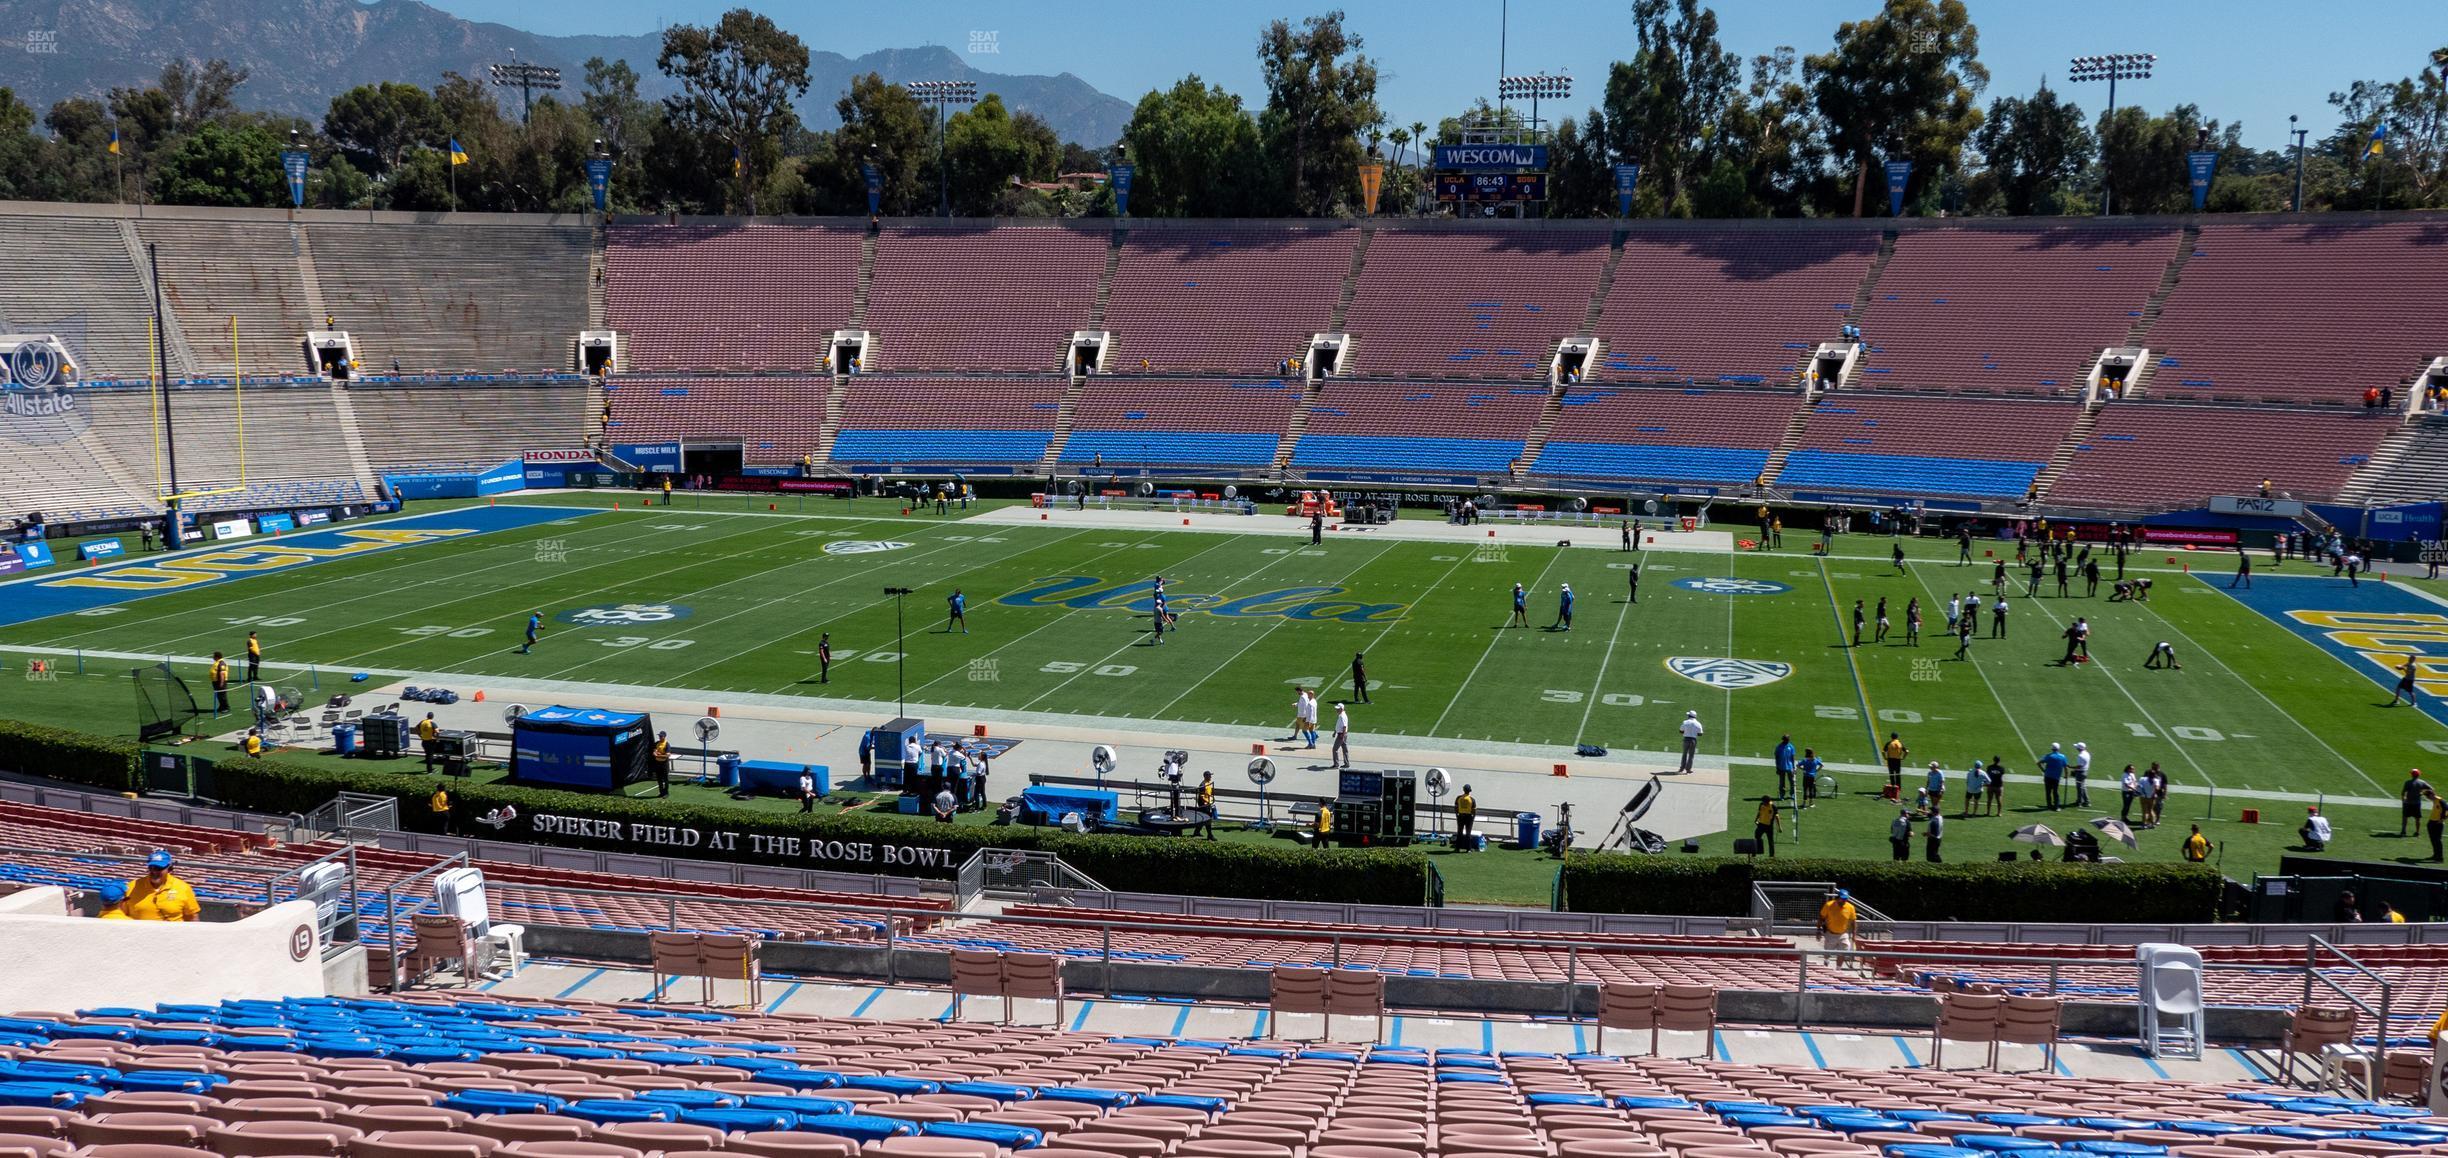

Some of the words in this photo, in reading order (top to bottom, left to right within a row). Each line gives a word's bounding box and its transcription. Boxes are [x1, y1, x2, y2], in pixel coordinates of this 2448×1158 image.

[1447, 149, 1514, 164] WESCOM
[1476, 176, 1503, 186] 86:43
[1450, 185, 1456, 193] 0
[1524, 185, 1530, 194] 0
[1484, 206, 1495, 216] 42
[4, 392, 75, 415] Allstate
[526, 450, 593, 460] HONDA
[635, 447, 659, 455] MUSCLE
[1332, 490, 1361, 500] FIELD
[1405, 493, 1430, 502] ROSE
[2404, 514, 2434, 522] Health
[33, 528, 481, 591] UCLA
[572, 609, 675, 620] 100
[1040, 660, 1138, 677] 50
[1540, 689, 1644, 707] 30
[1814, 705, 1924, 724] 20
[2122, 722, 2226, 741] 10
[532, 814, 624, 840] SPIEKER
[631, 823, 700, 846] FIELD
[708, 830, 739, 850] AT
[750, 834, 800, 856] THE
[810, 839, 873, 862] ROSE
[882, 844, 958, 868] BOWL
[294, 930, 308, 954] 19
